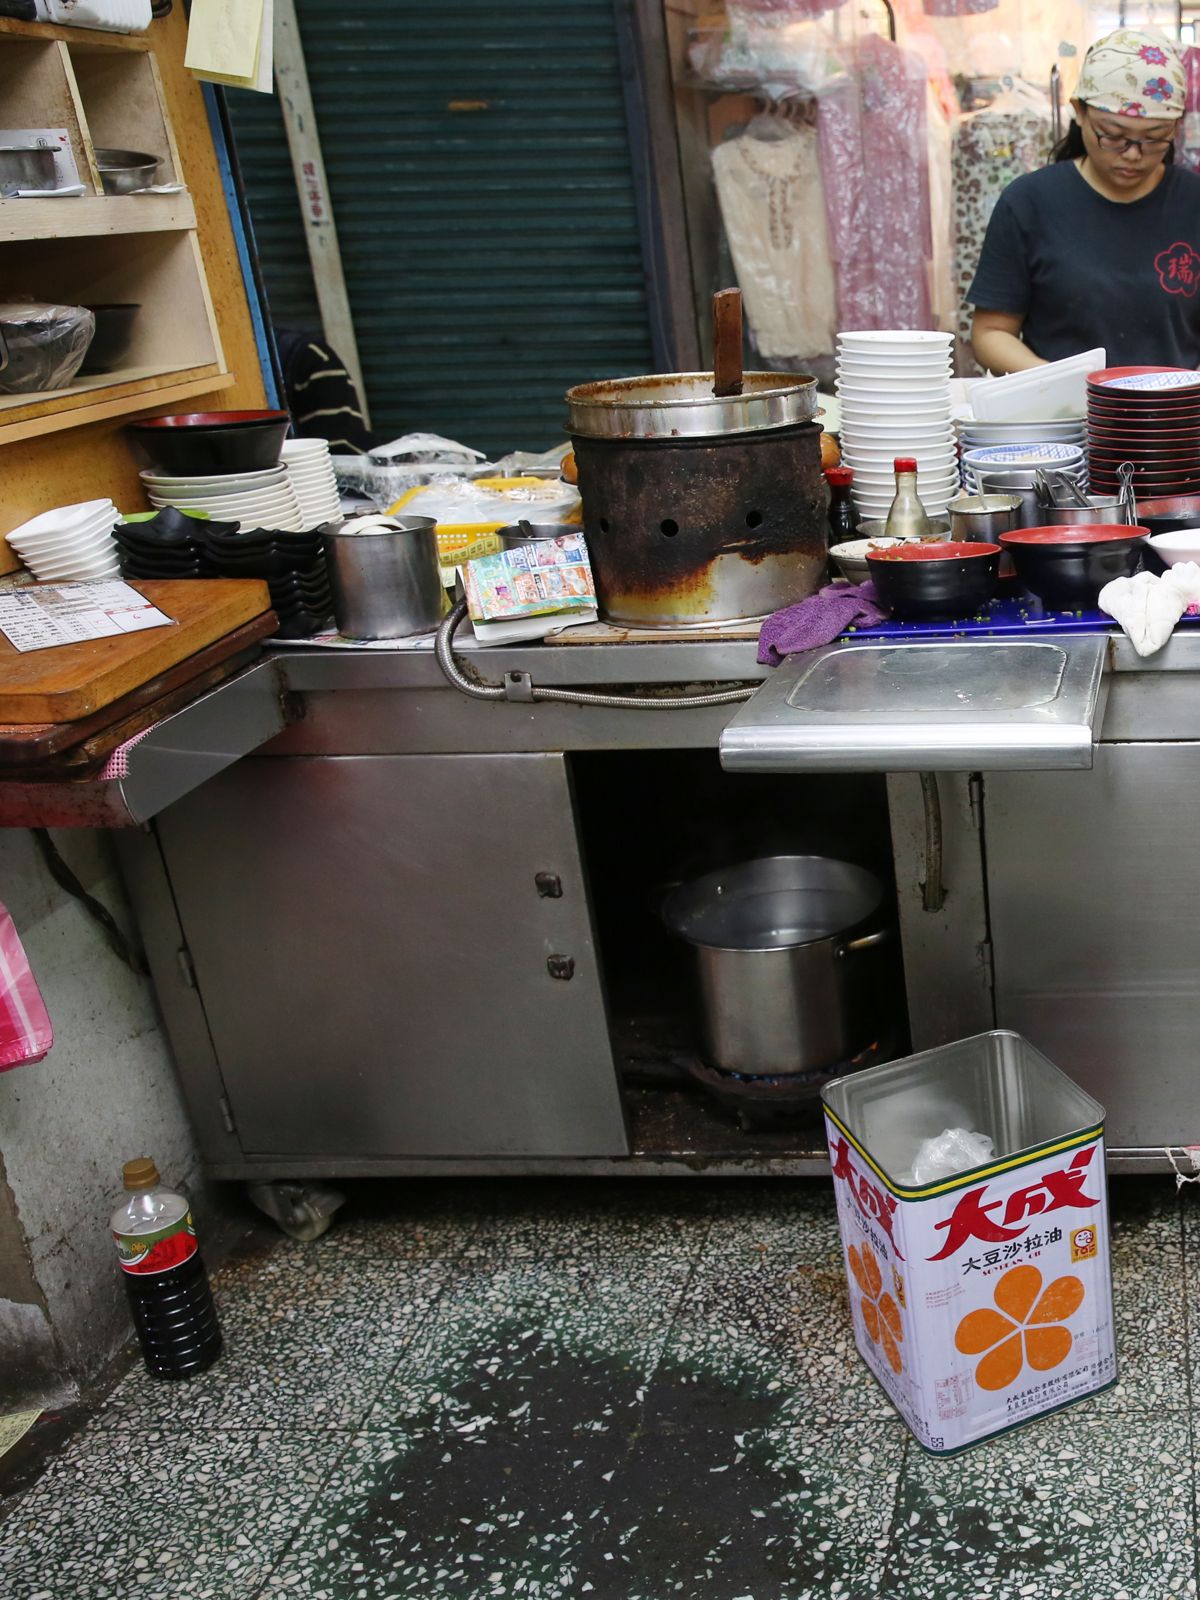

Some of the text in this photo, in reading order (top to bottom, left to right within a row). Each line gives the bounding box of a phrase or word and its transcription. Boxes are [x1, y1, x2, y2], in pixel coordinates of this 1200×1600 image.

[1168, 253, 1193, 284] 瑞
[830, 1136, 906, 1261] 大成
[924, 1145, 1101, 1261] 大成
[961, 1226, 1063, 1277] 大豆沙拉油
